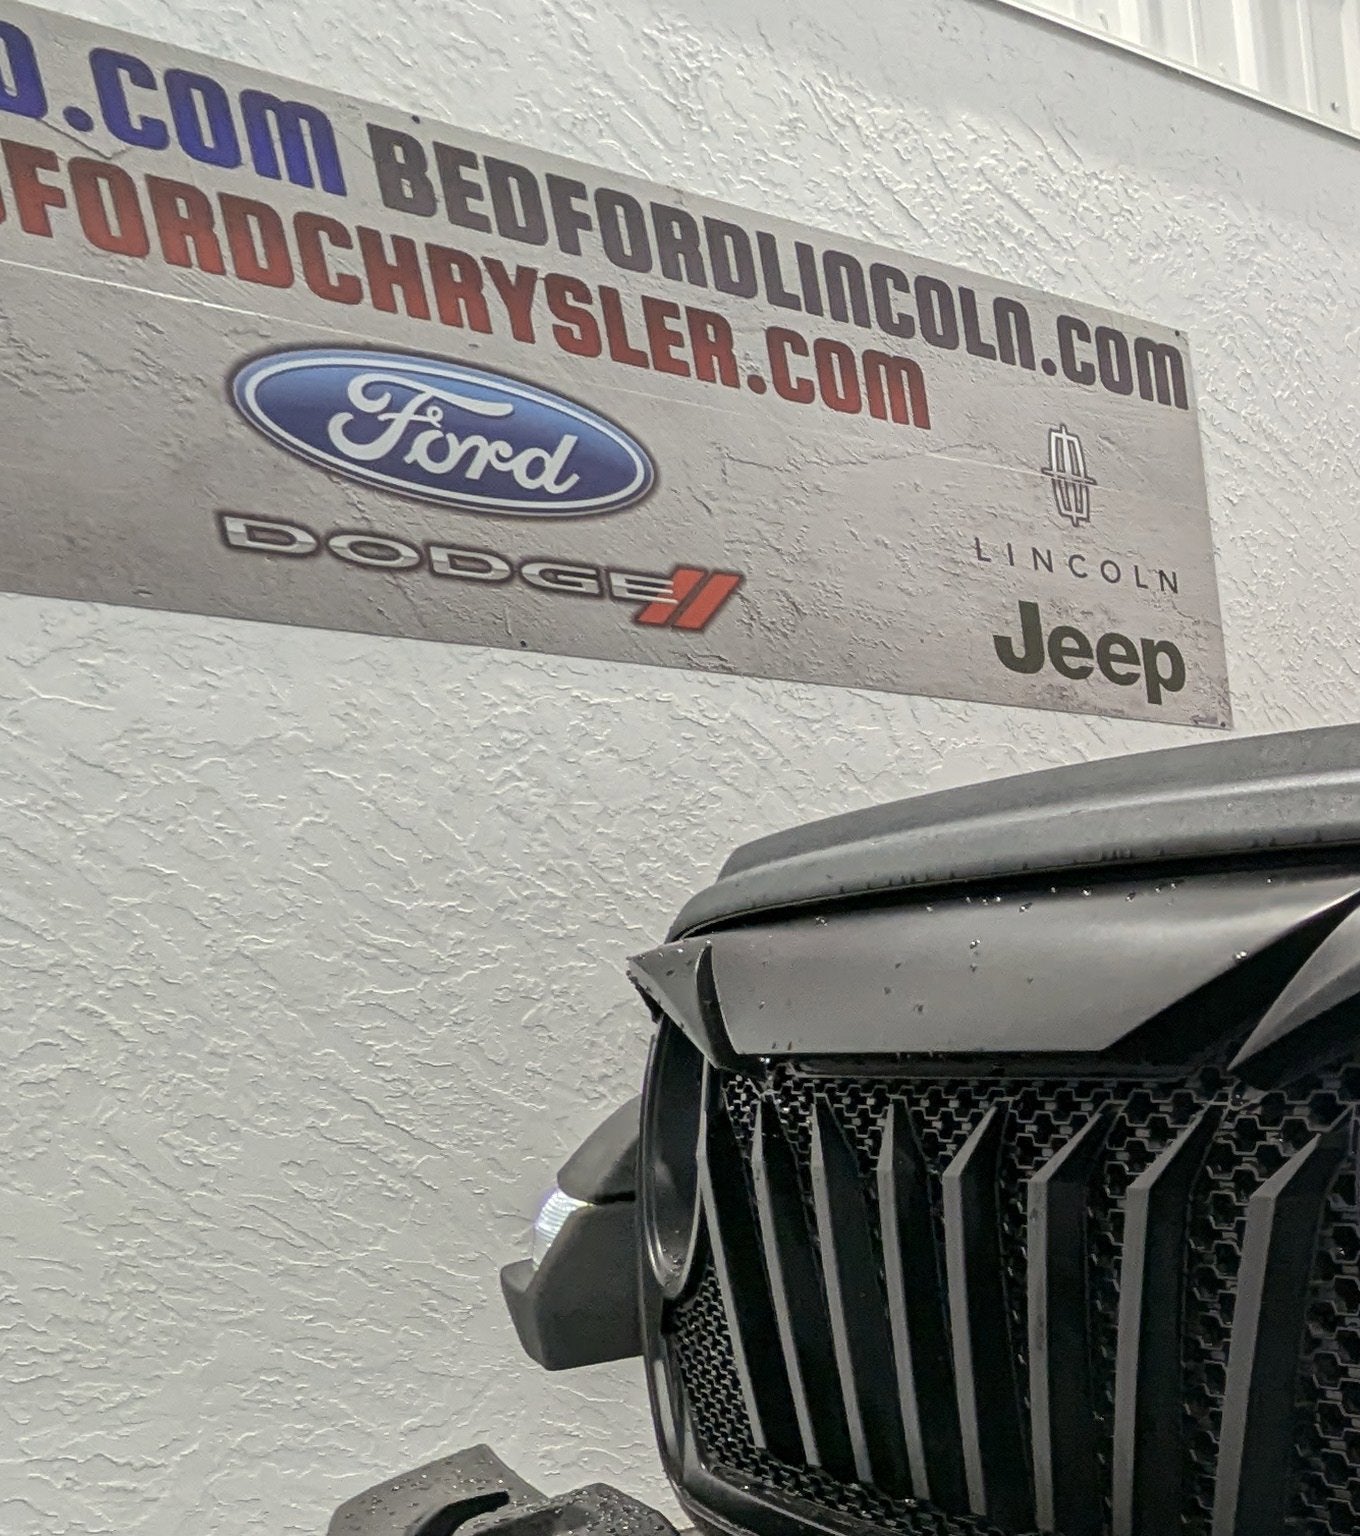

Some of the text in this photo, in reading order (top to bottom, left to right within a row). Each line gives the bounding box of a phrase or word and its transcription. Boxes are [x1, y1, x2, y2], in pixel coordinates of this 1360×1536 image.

[0, 138, 931, 430] FORDCHRYSLER.COM
[365, 122, 1190, 411] BEDFORDLINCOLN.COM
[327, 372, 580, 495] Ford
[220, 512, 680, 604] DODGE
[973, 536, 1179, 595] LINCOLN
[993, 600, 1186, 705] Jeep
